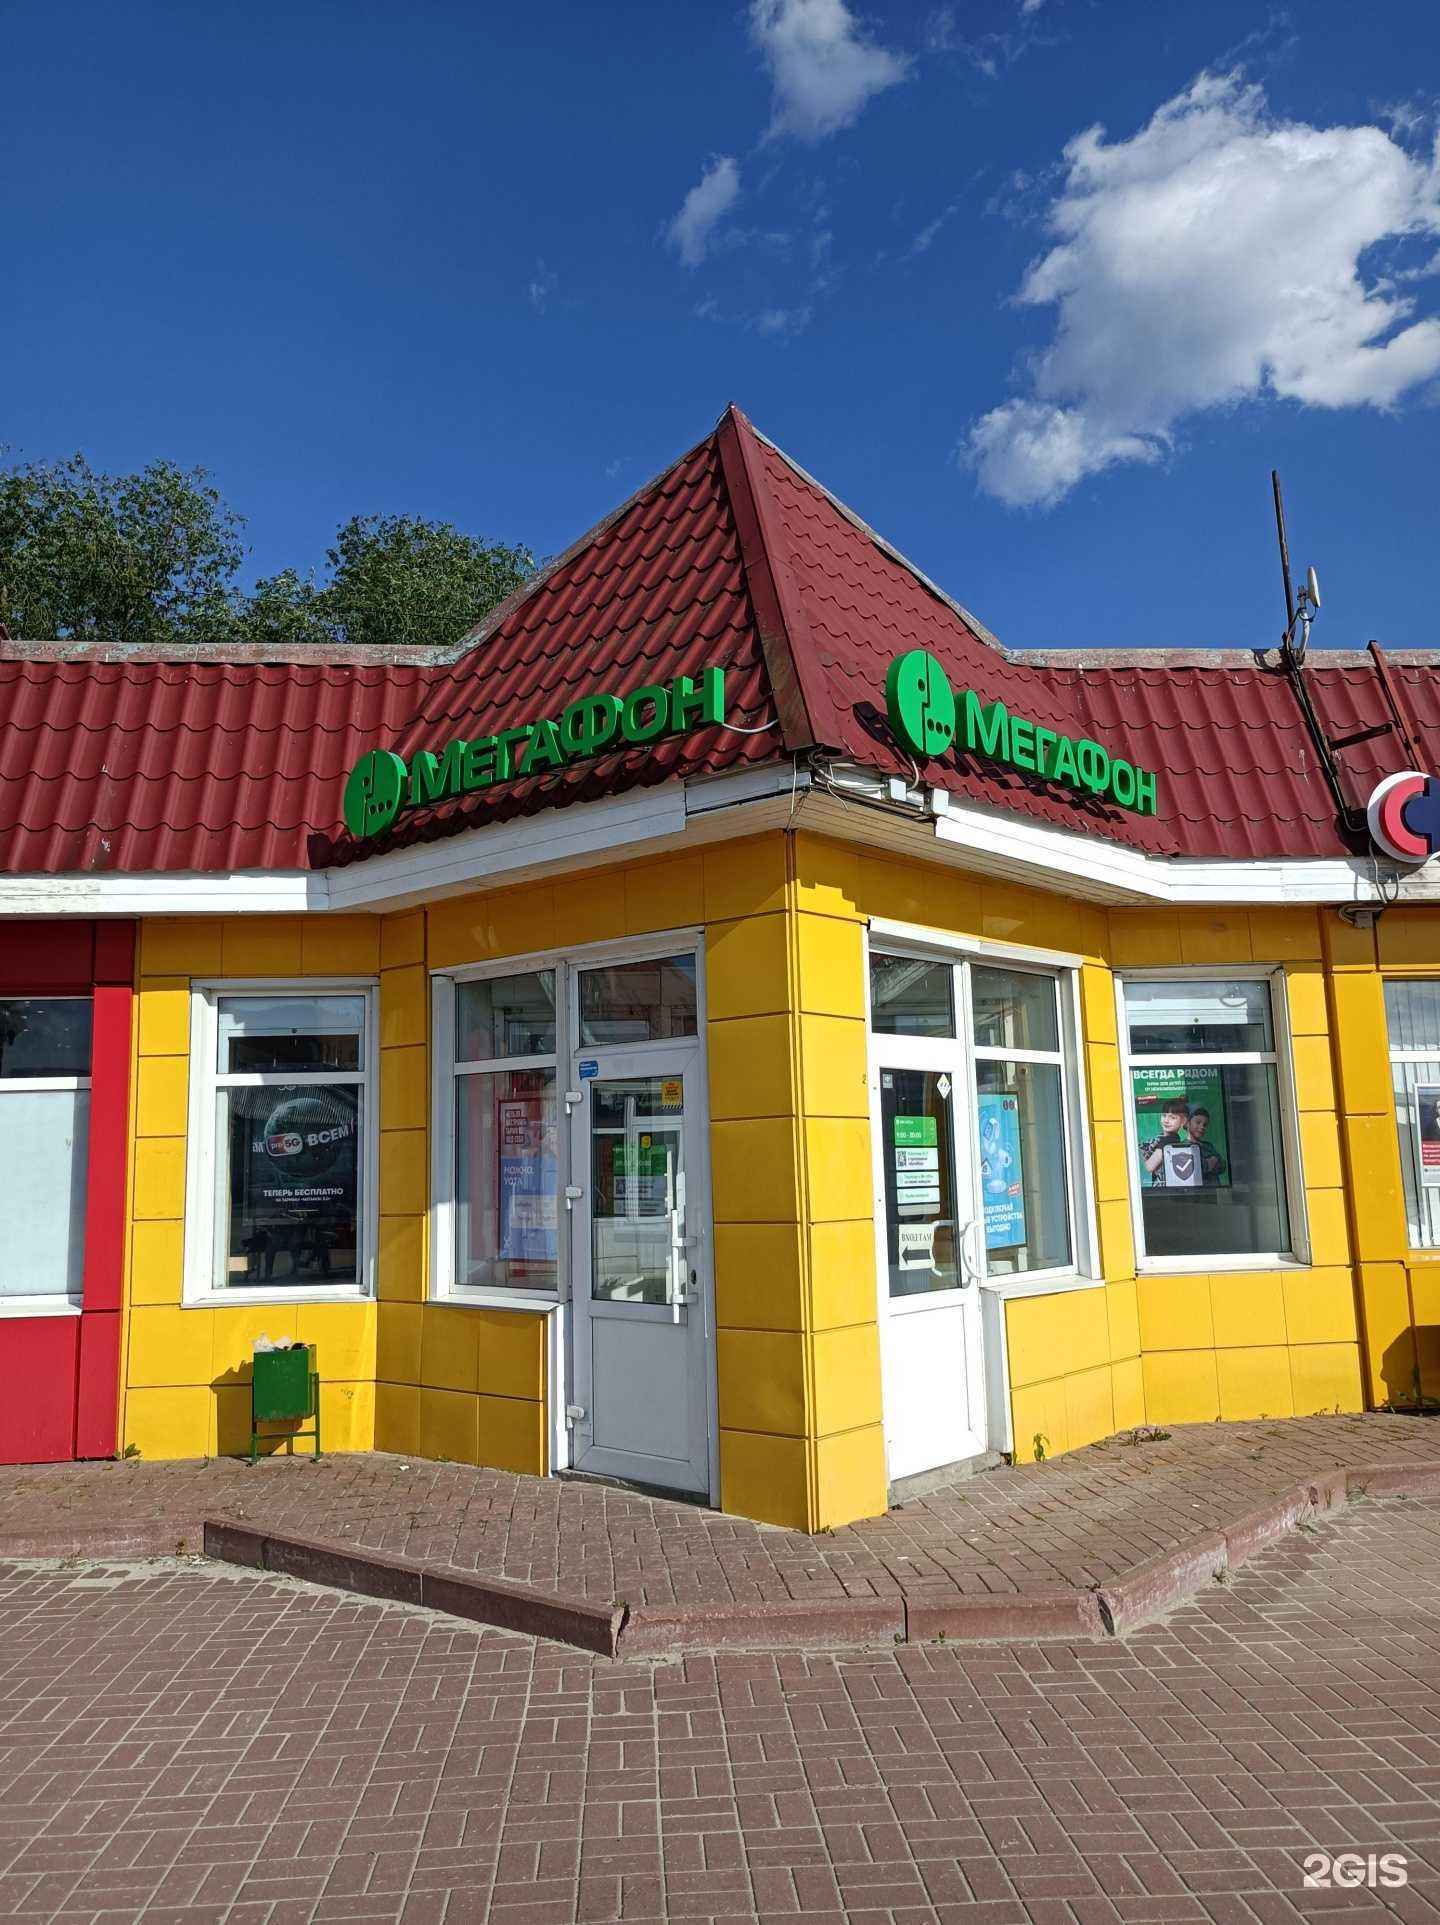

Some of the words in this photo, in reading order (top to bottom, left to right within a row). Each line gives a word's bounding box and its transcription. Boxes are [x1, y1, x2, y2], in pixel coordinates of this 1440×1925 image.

[1133, 1069, 1175, 1080] ВСЕГДА
[1177, 1068, 1218, 1078] РЯДОМ
[307, 1124, 350, 1147] ВСЕМ
[263, 1189, 293, 1197] ТЕПЕРЬ
[295, 1187, 344, 1196] БЕСПЛАТНО
